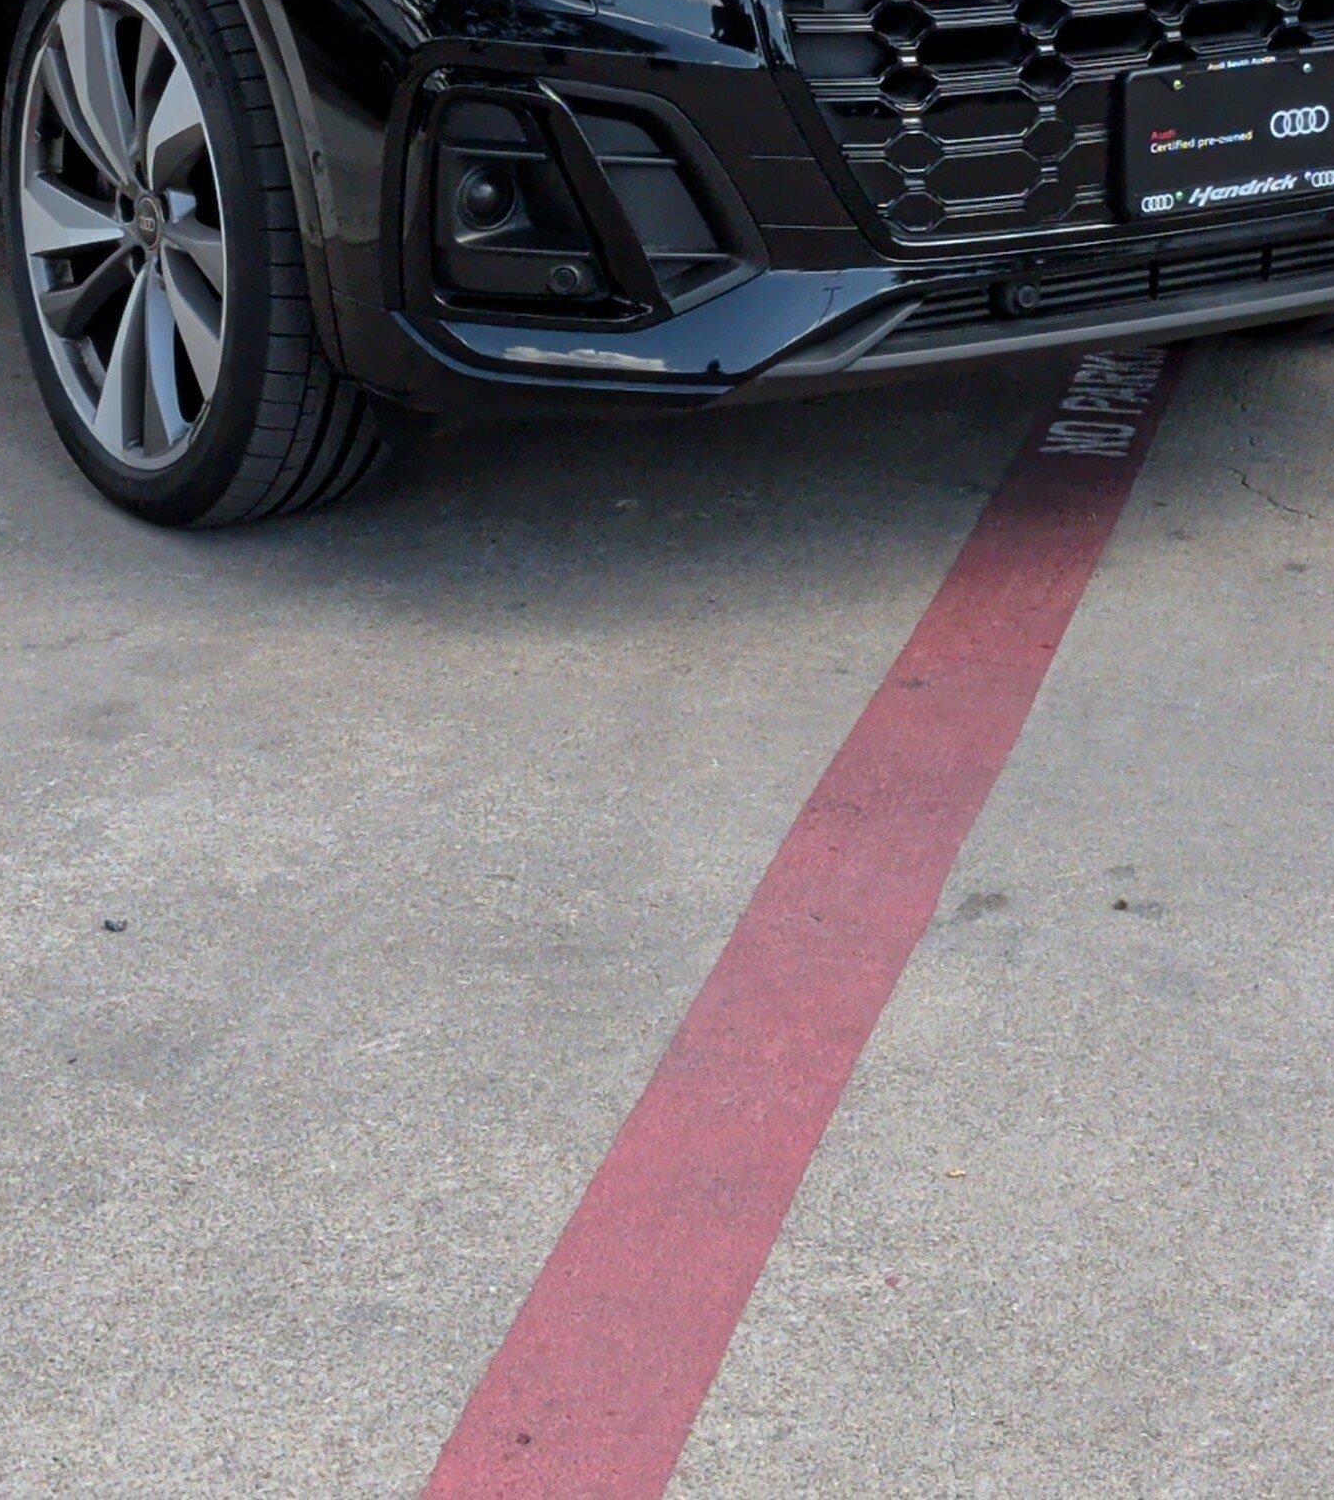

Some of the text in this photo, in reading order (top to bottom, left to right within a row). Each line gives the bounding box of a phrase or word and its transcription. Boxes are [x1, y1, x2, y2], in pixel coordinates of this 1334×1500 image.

[1150, 129, 1177, 140] Audi
[1150, 129, 1254, 154] Certified pre-owned
[1187, 173, 1299, 208] Hendrick
[1038, 420, 1138, 458] NO
